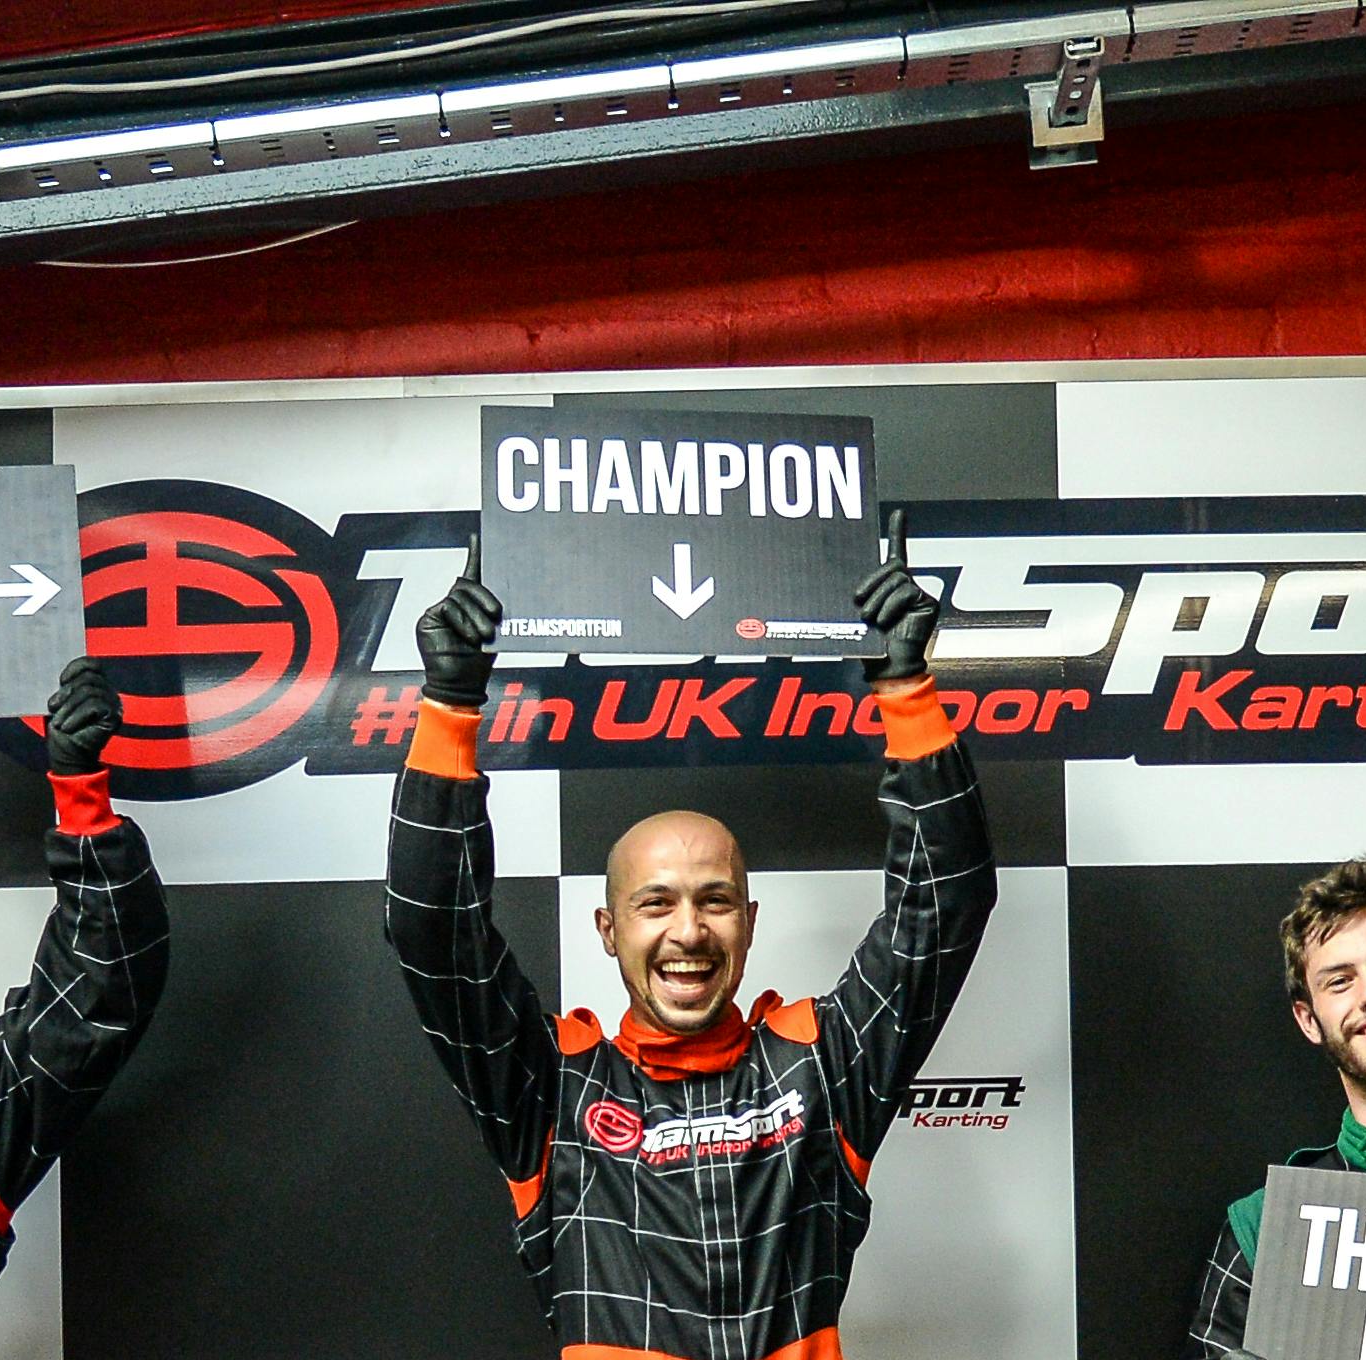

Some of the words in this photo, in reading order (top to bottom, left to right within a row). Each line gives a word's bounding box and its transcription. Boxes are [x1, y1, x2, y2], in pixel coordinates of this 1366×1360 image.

[497, 436, 863, 520] CHAMPION
[500, 618, 622, 638] #TEAMSPORTFUN
[487, 683, 573, 745] in
[593, 677, 755, 740] UK
[913, 1111, 1010, 1130] Karting
